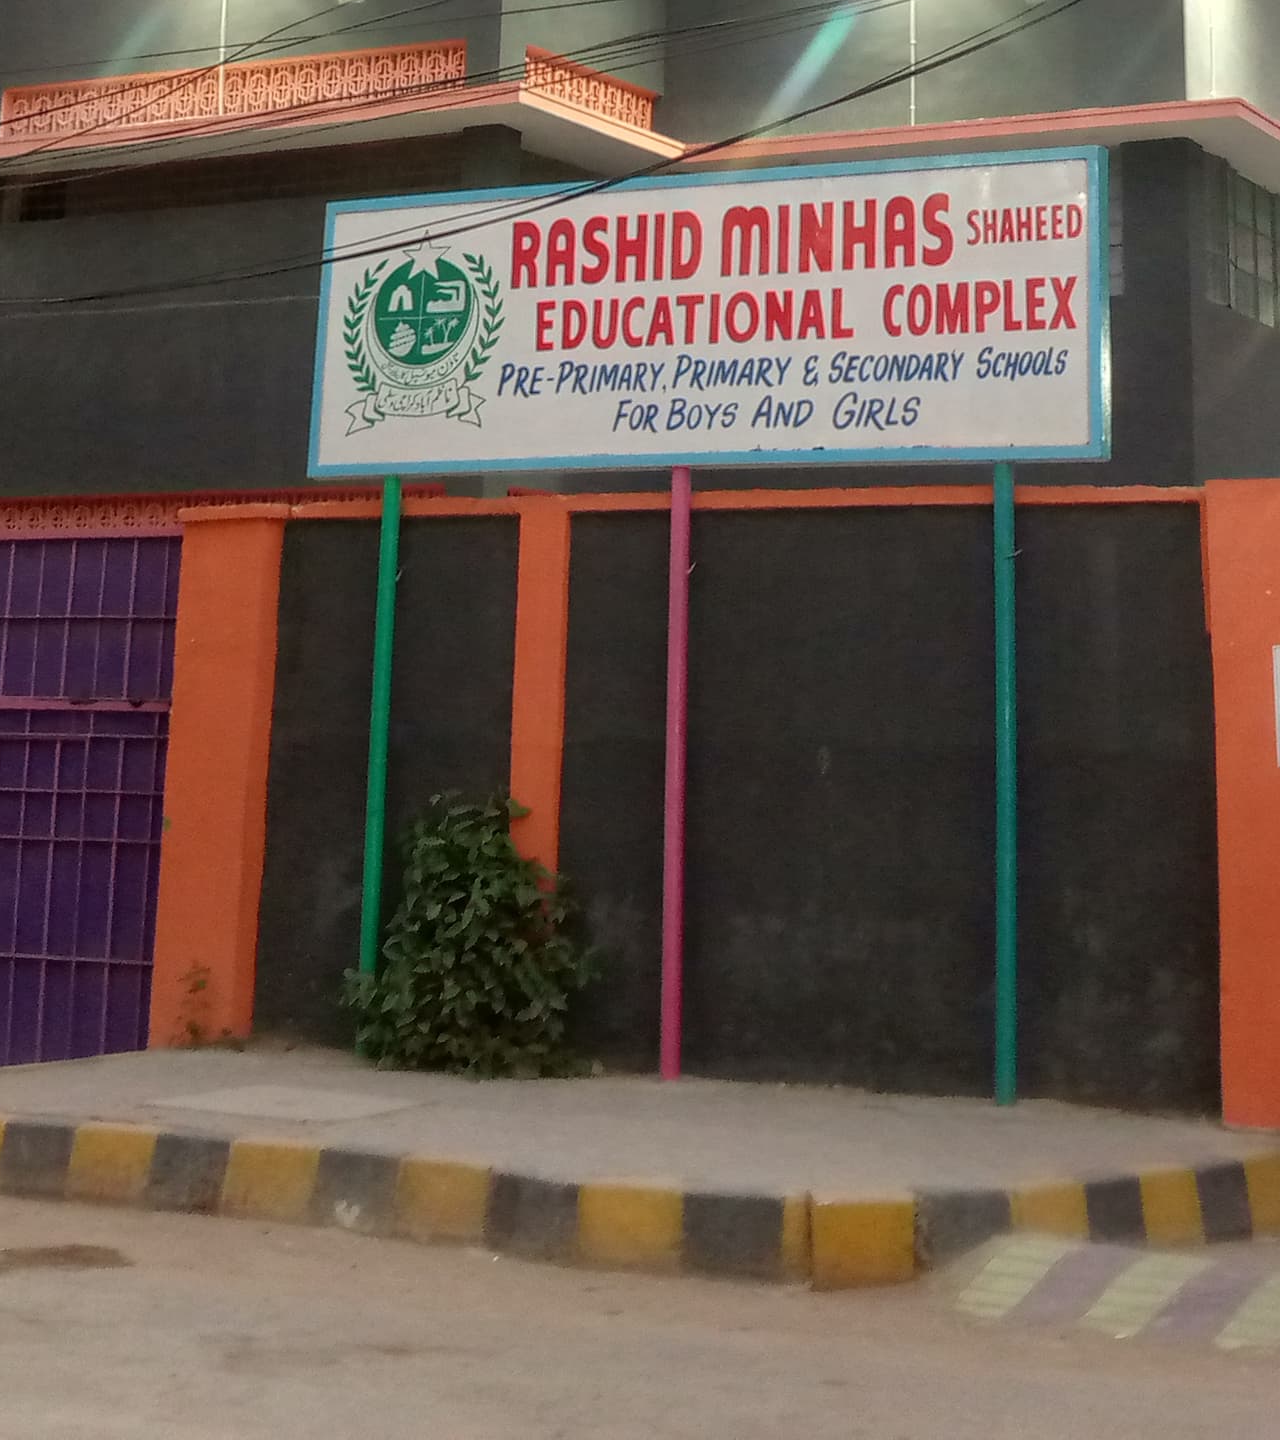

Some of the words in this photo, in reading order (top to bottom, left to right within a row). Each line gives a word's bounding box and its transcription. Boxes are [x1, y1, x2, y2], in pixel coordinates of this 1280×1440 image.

[510, 210, 703, 289] RASHID
[720, 192, 954, 277] MINHAS
[966, 203, 1083, 246] SHAHEED
[535, 287, 855, 352] EDUCATIONAL
[882, 275, 1078, 337] COMPLEX
[671, 354, 793, 392] PRIMARY
[803, 355, 820, 387] &
[828, 349, 965, 384] SECONDARY
[975, 345, 1069, 381] SCHOOLS
[612, 399, 660, 433] FOR
[666, 397, 739, 432] BOYS
[751, 394, 815, 429] AND
[832, 391, 922, 431] GIRLS
